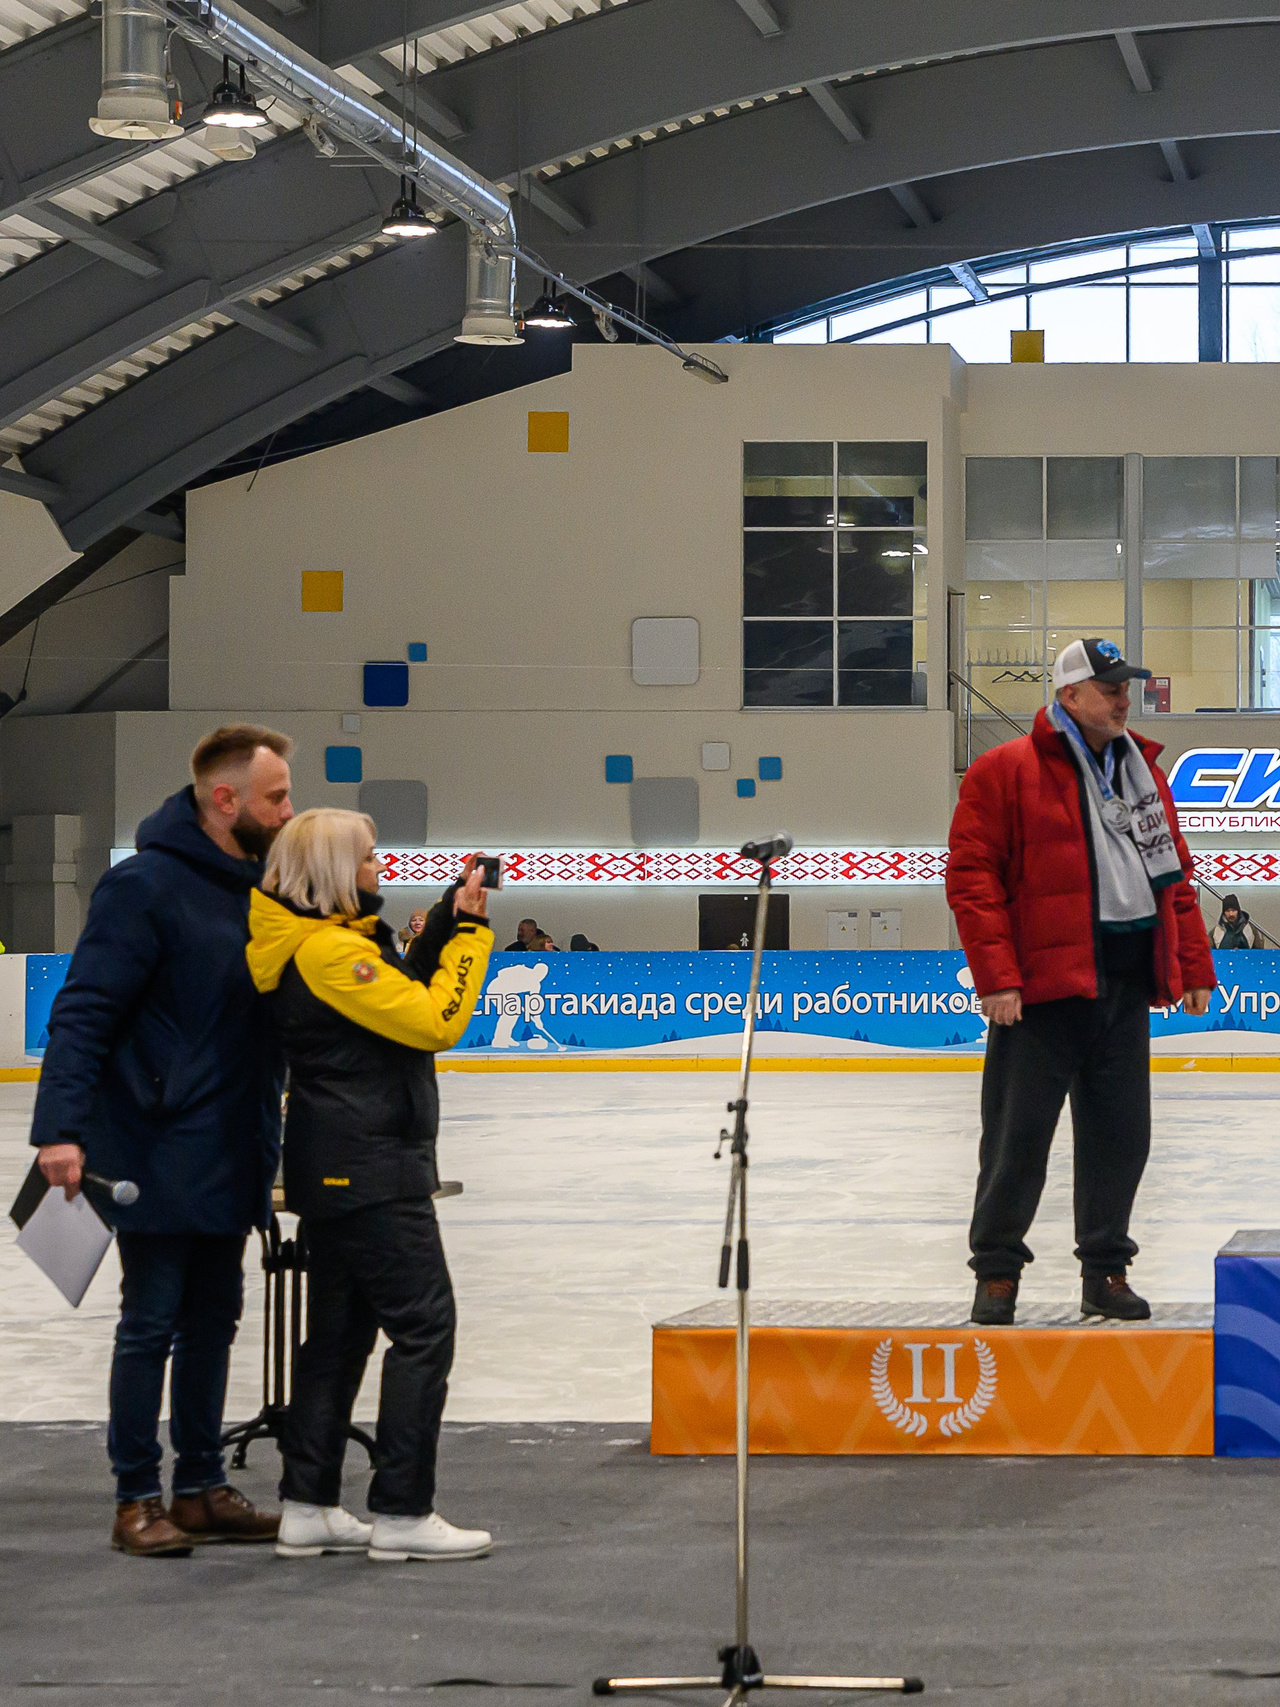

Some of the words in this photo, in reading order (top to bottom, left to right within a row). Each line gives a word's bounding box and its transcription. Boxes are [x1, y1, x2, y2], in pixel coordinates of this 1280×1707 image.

[684, 992, 782, 1022] среди
[793, 984, 983, 1022] работников
[903, 1342, 964, 1403] II
